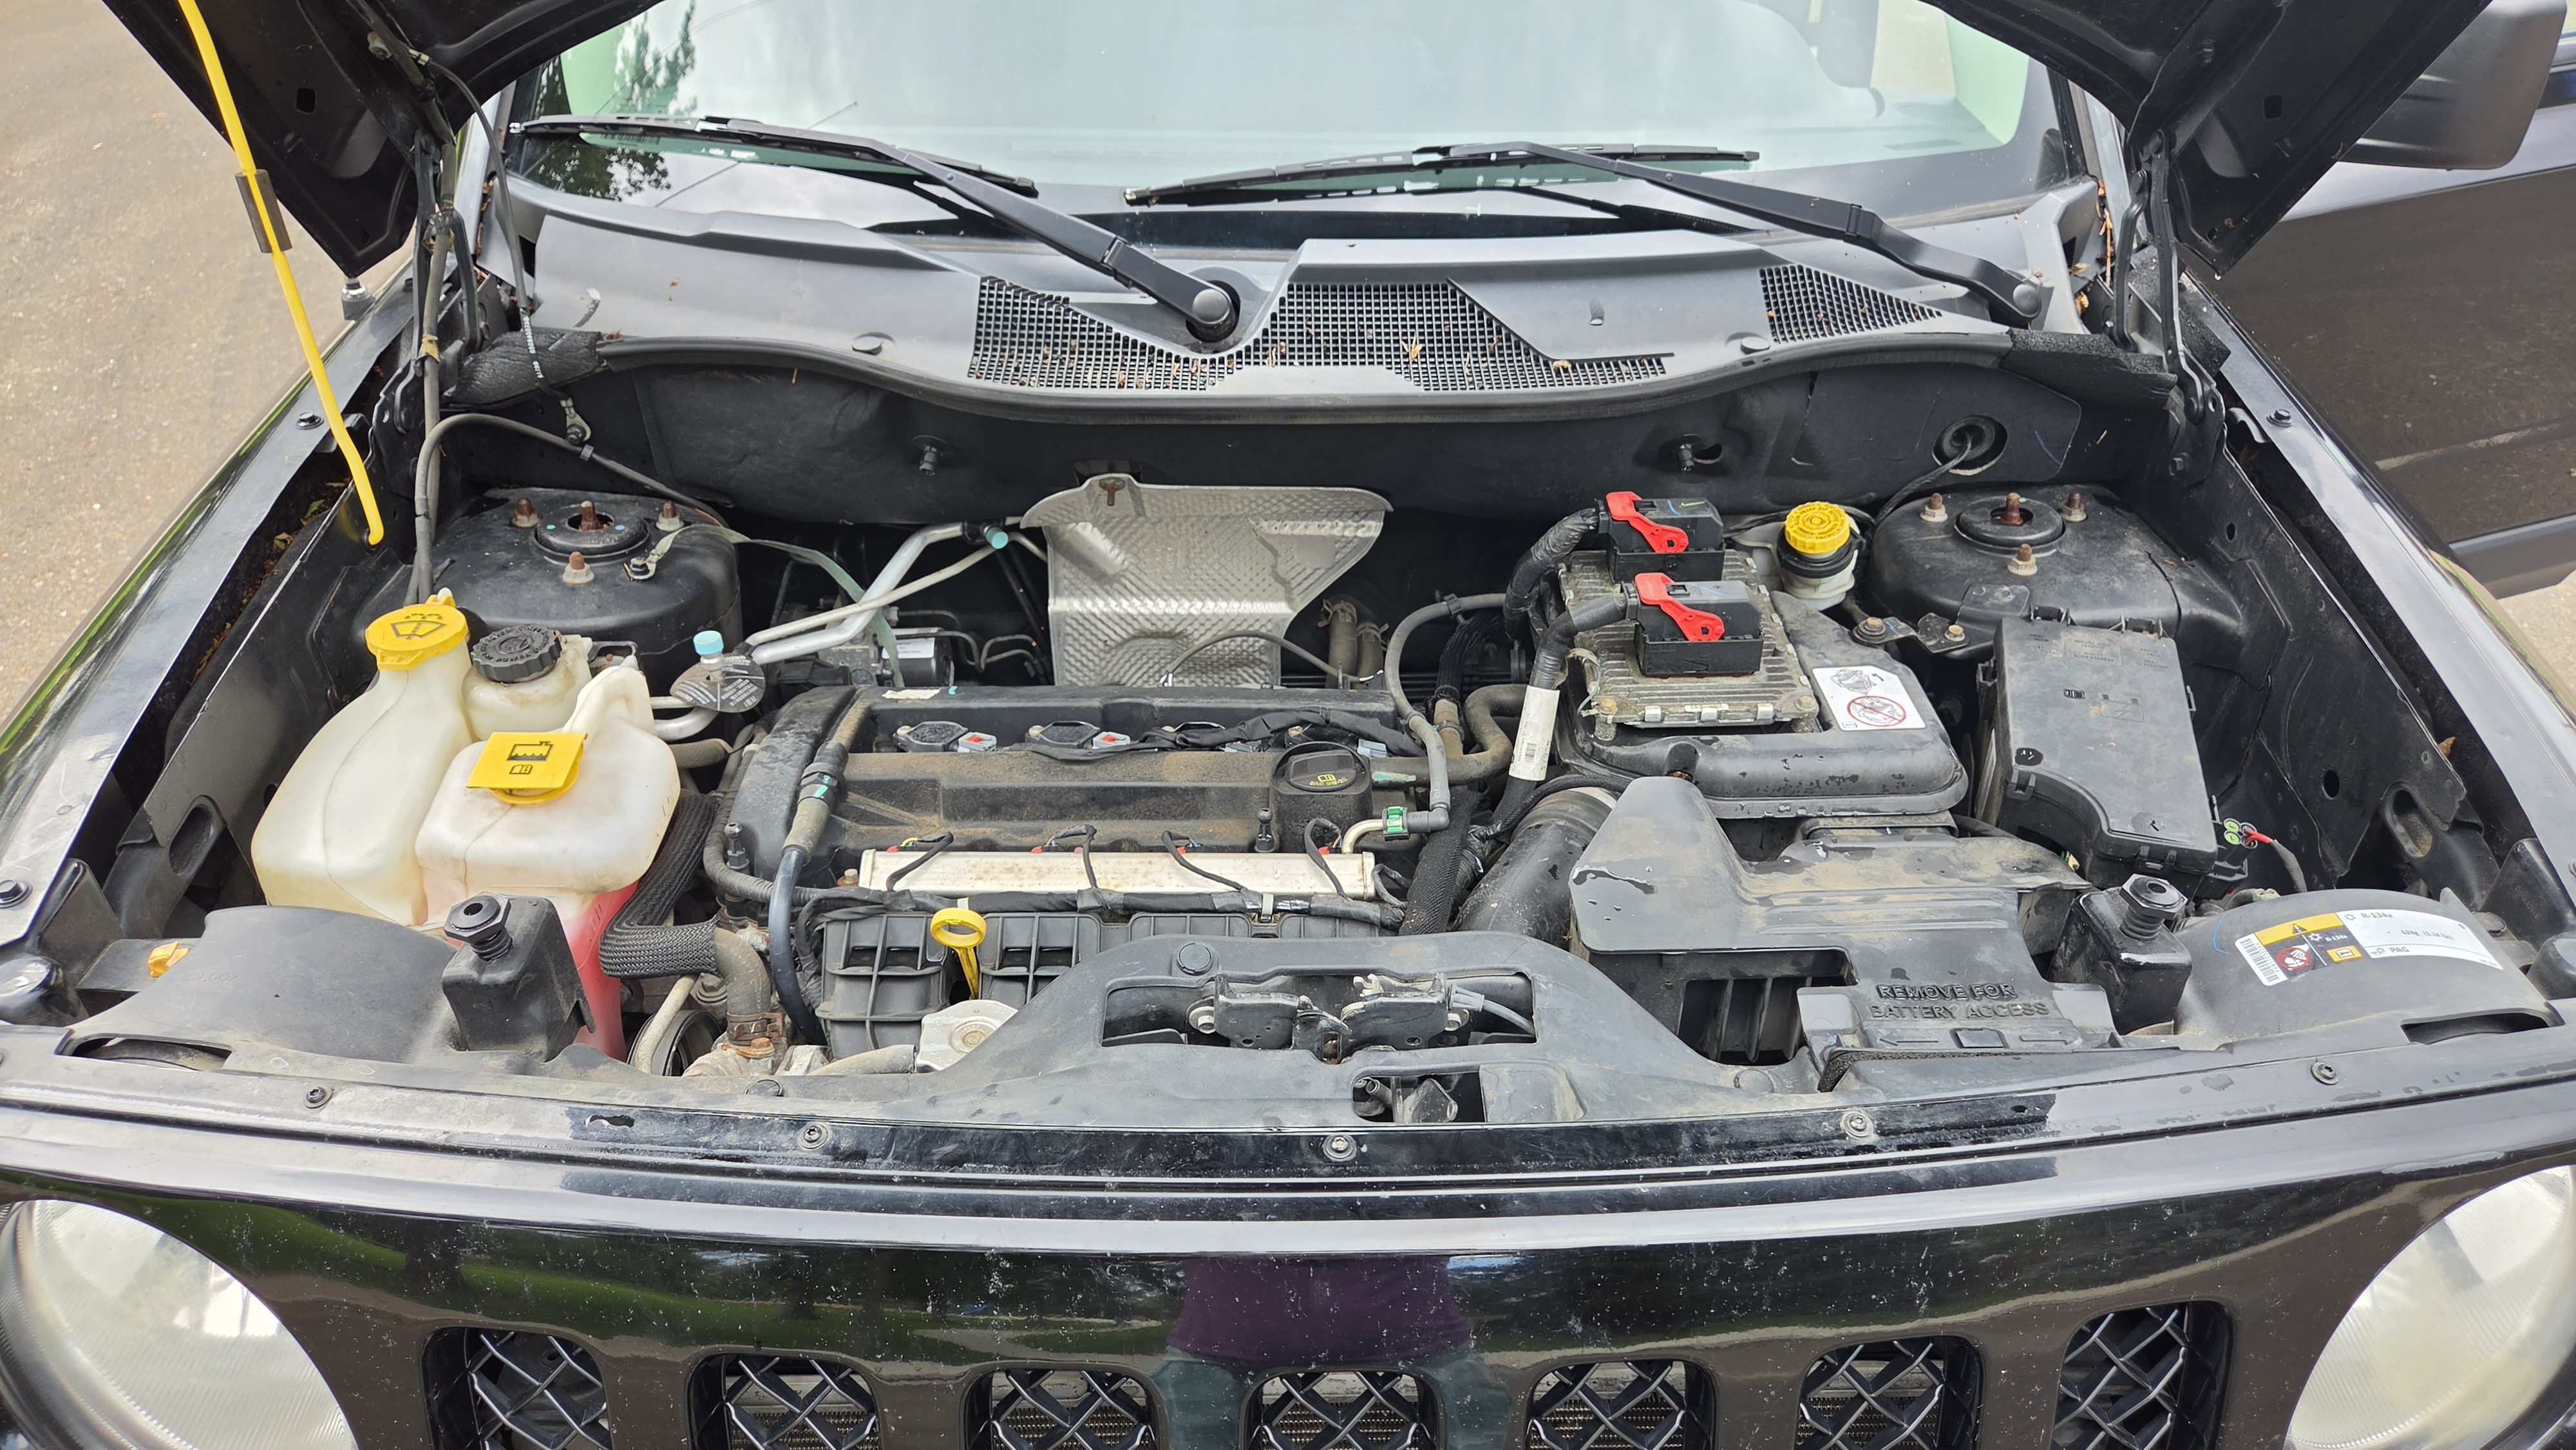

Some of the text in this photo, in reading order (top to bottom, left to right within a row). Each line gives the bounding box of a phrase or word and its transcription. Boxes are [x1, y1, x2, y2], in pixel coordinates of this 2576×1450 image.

[1875, 983, 2018, 1000] REMOVE FOR
[1870, 1002, 2050, 1019] BATTERY ACCESS
